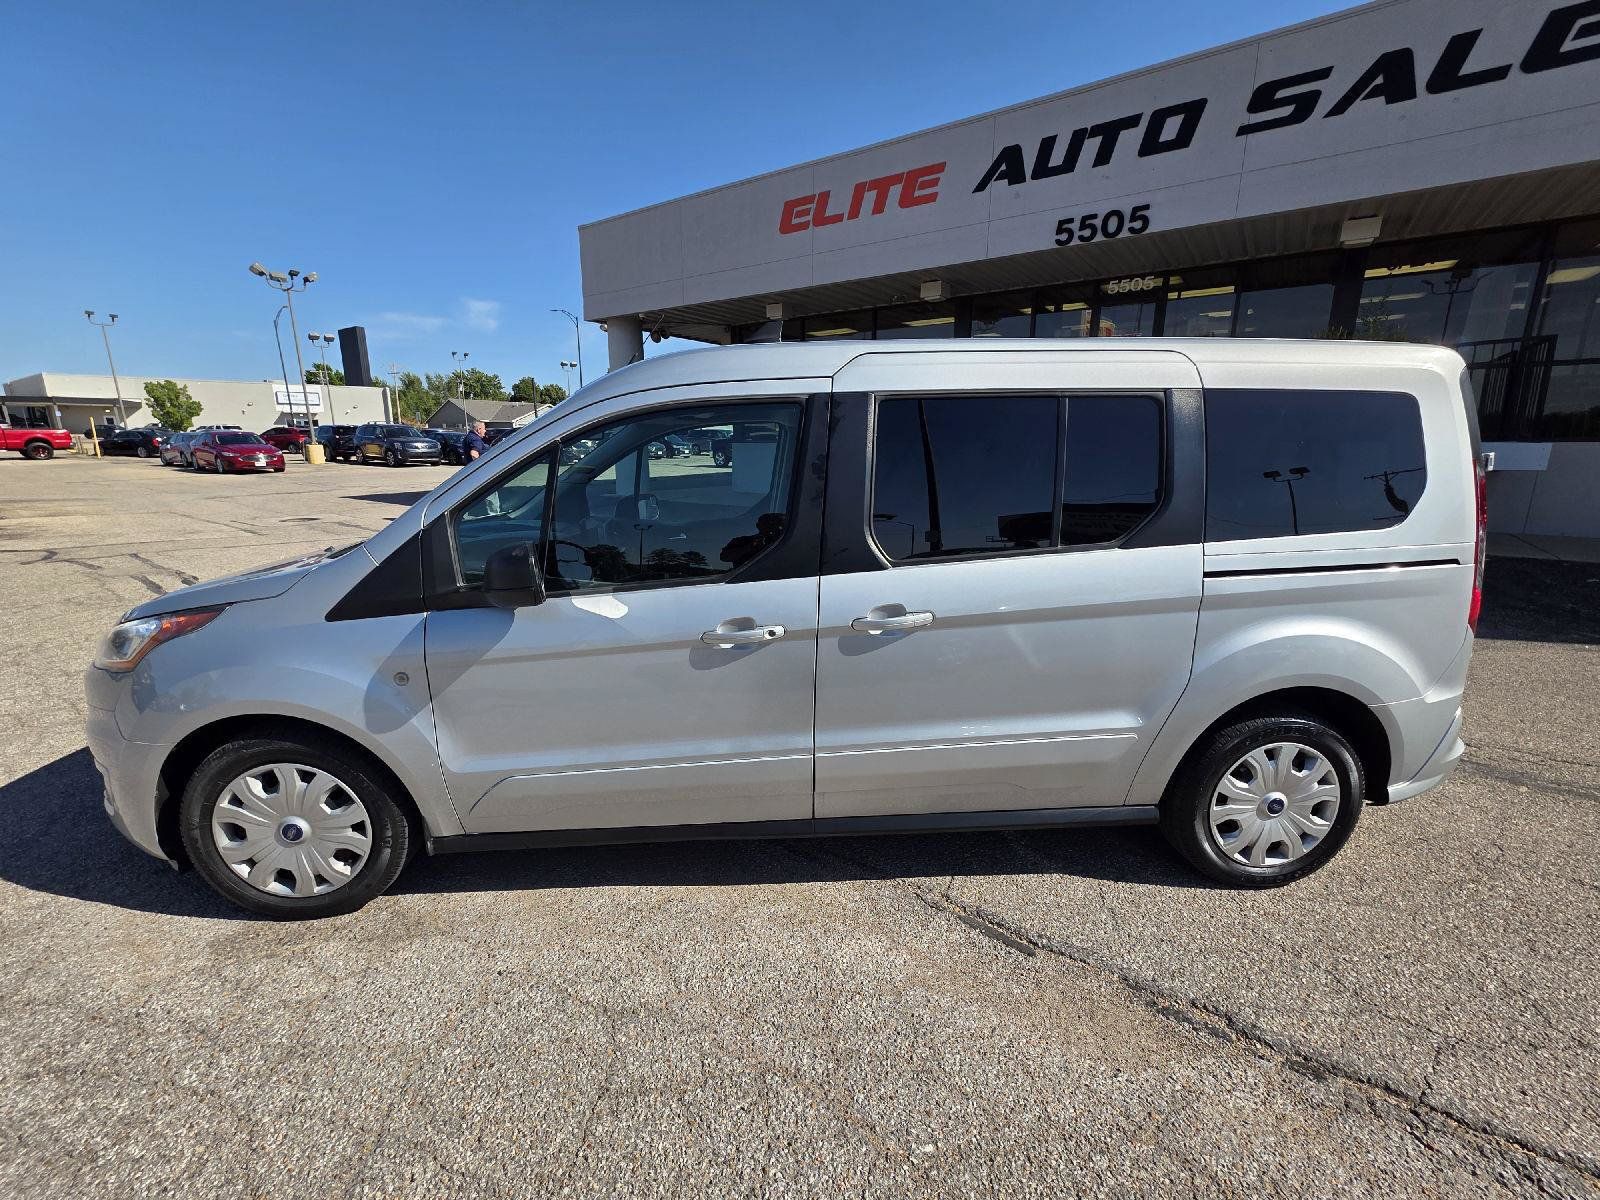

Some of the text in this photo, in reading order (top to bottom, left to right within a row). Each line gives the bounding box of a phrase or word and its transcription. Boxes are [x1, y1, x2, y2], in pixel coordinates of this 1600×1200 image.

[779, 161, 947, 235] ELITE
[972, 97, 1208, 194] AUTO
[1055, 204, 1151, 247] 5505
[1107, 276, 1155, 295] 5505
